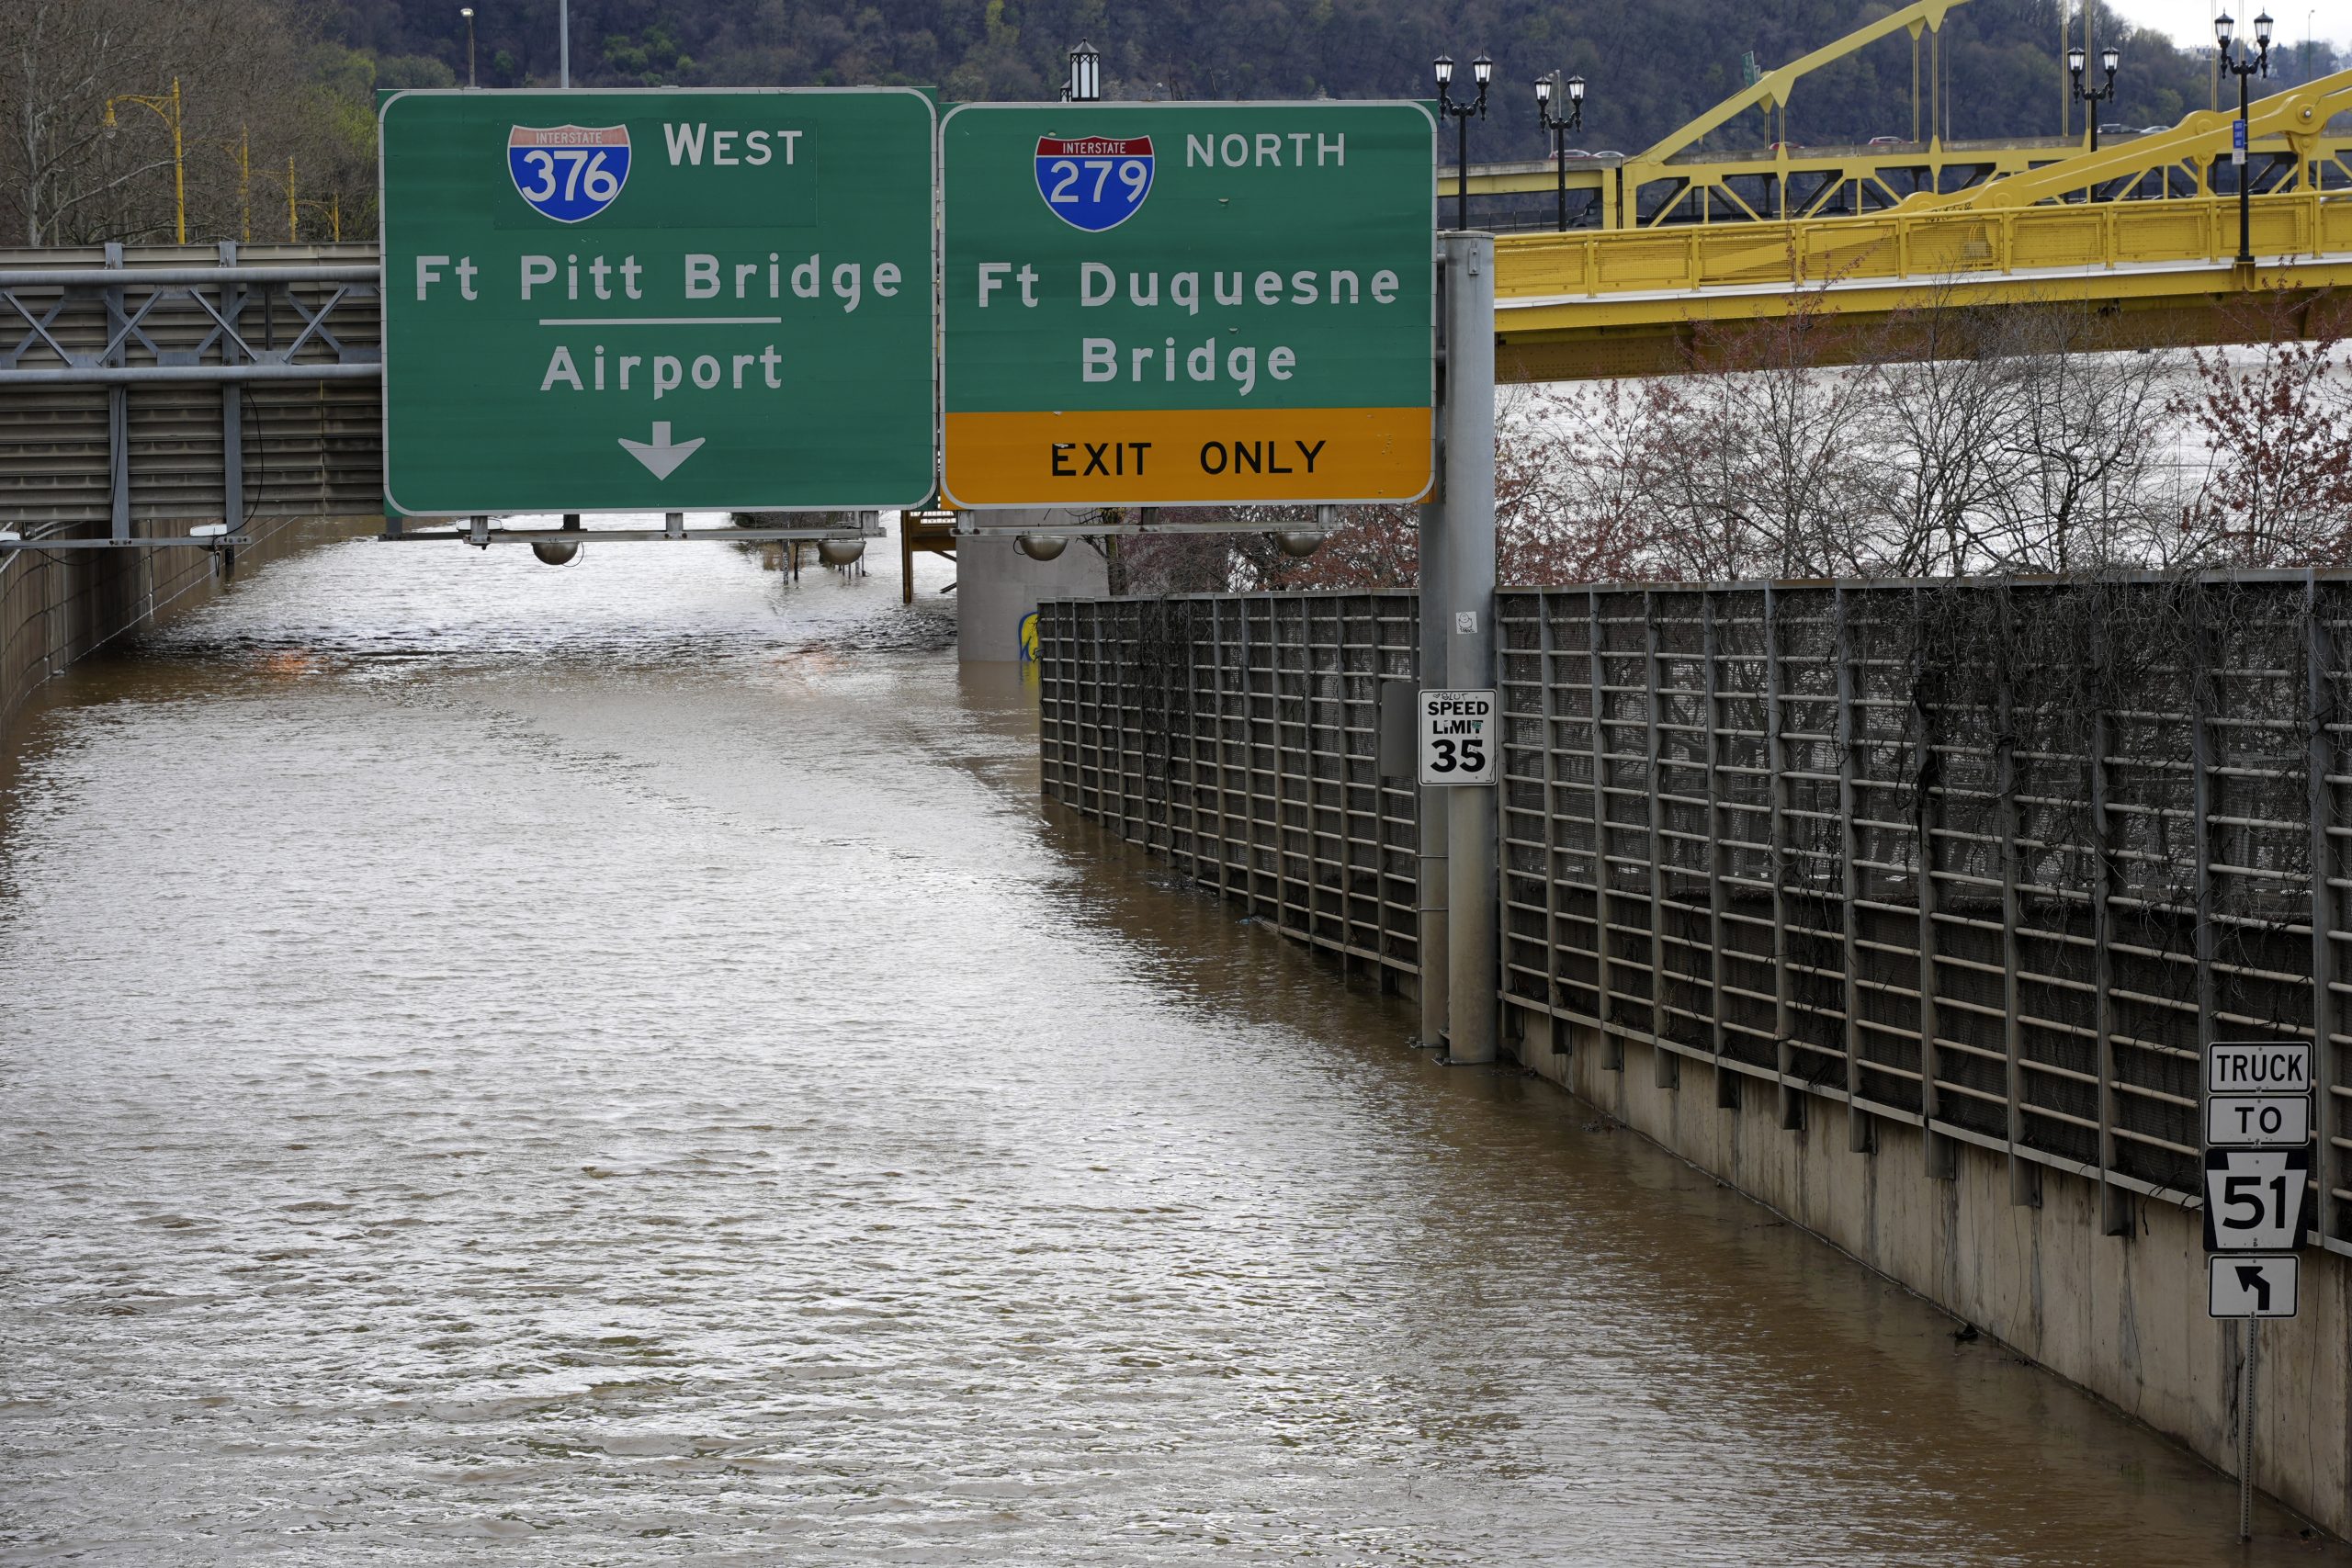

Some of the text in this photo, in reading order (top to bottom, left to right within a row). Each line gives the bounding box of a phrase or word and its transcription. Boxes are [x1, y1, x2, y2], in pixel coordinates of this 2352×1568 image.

[536, 132, 603, 144] INTERSTATE
[663, 123, 803, 165] WEST
[1062, 141, 1126, 154] INTERSTATE
[1186, 132, 1345, 167] NORTH
[521, 150, 618, 202] 376
[1050, 160, 1148, 203] 279
[415, 253, 902, 313] Ft Pitt Bridge
[978, 262, 1399, 316] Ft Duquesne
[539, 344, 783, 400] Airport
[1082, 337, 1296, 396] Bridge
[1051, 440, 1327, 477] EXIT ONLY
[1428, 701, 1489, 716] SPEED
[1432, 720, 1484, 735] LIMIT
[1430, 739, 1486, 773] 35
[2216, 1054, 2303, 1082] TRUCK
[2234, 1106, 2282, 1134] TO
[2222, 1175, 2287, 1230] 51
